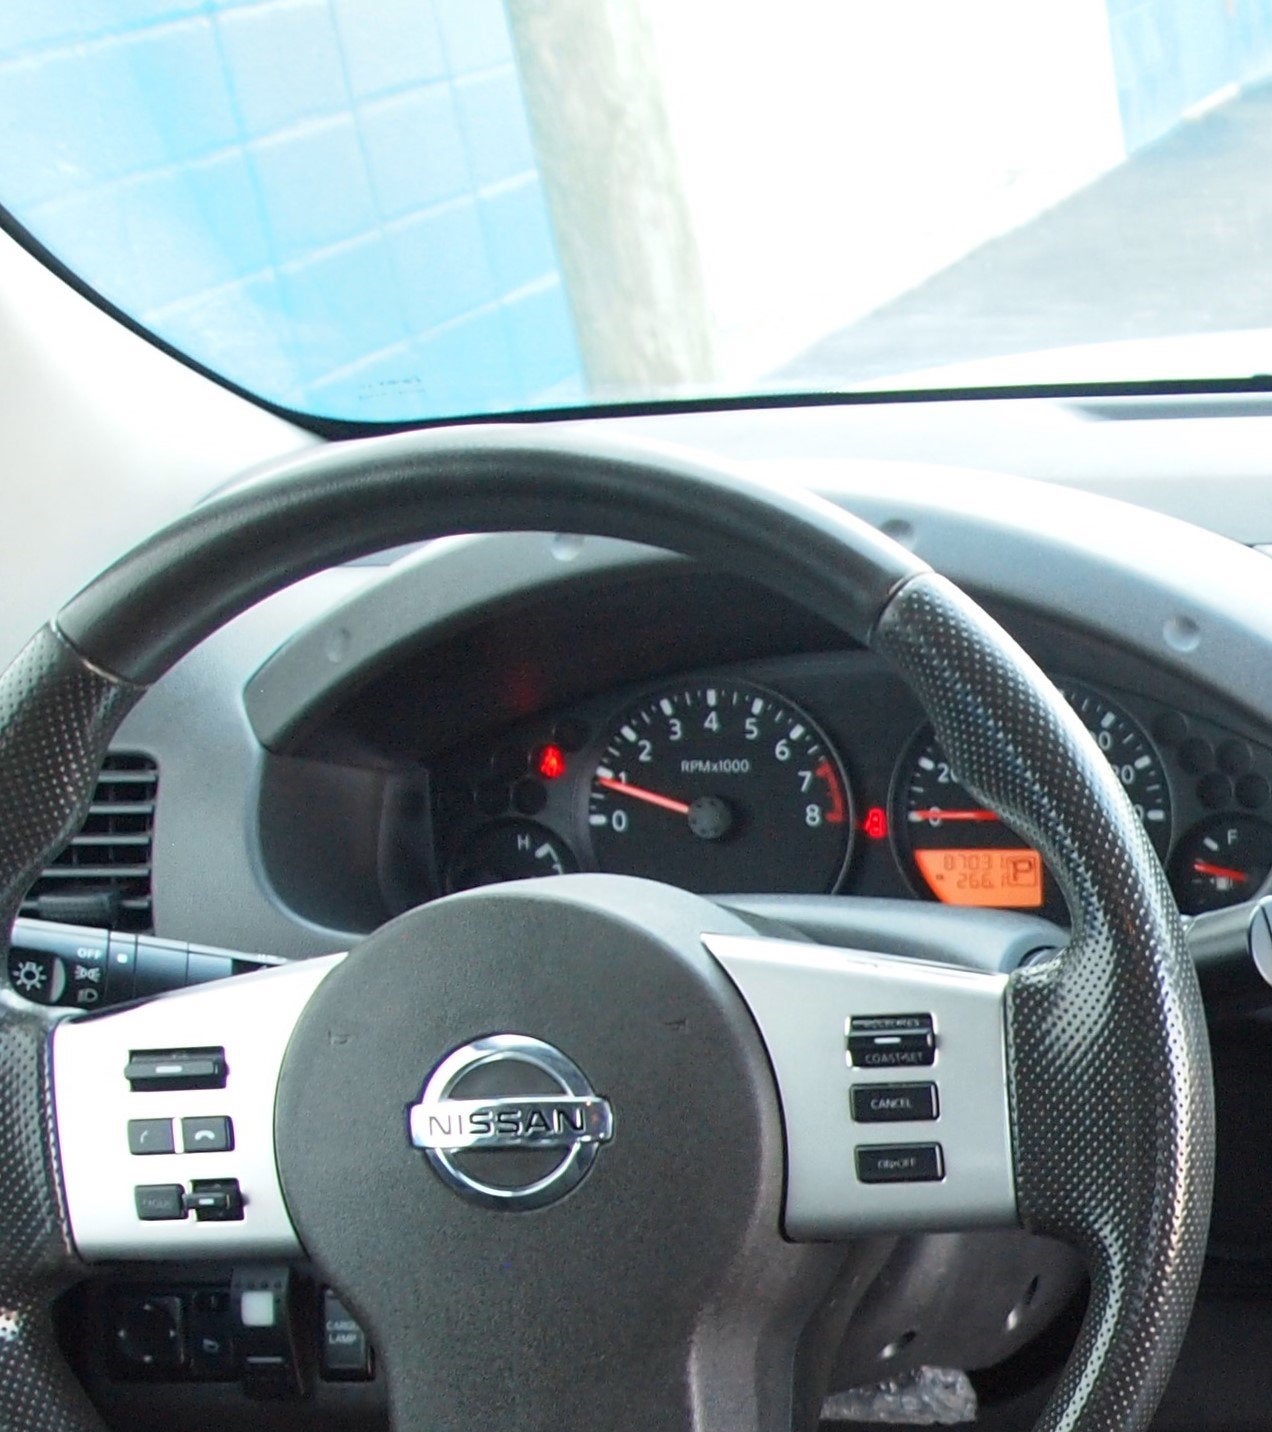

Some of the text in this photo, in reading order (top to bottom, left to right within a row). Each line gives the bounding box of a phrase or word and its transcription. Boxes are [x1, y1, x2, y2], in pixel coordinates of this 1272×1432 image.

[668, 719, 682, 741] 3
[703, 711, 719, 732] 4
[744, 718, 759, 740] 5
[637, 740, 652, 762] 2
[774, 739, 790, 761] 6
[681, 759, 749, 773] RPMx1000
[797, 771, 811, 792] 7
[611, 810, 628, 832] 0
[805, 803, 821, 827] 8
[517, 834, 530, 851] H
[1227, 829, 1239, 845] F
[1012, 859, 1032, 882] P
[76, 948, 101, 960] OFF
[870, 1098, 913, 1110] CANCEL
[428, 1108, 587, 1137] NISSAN
[328, 1333, 357, 1345] LAMP
